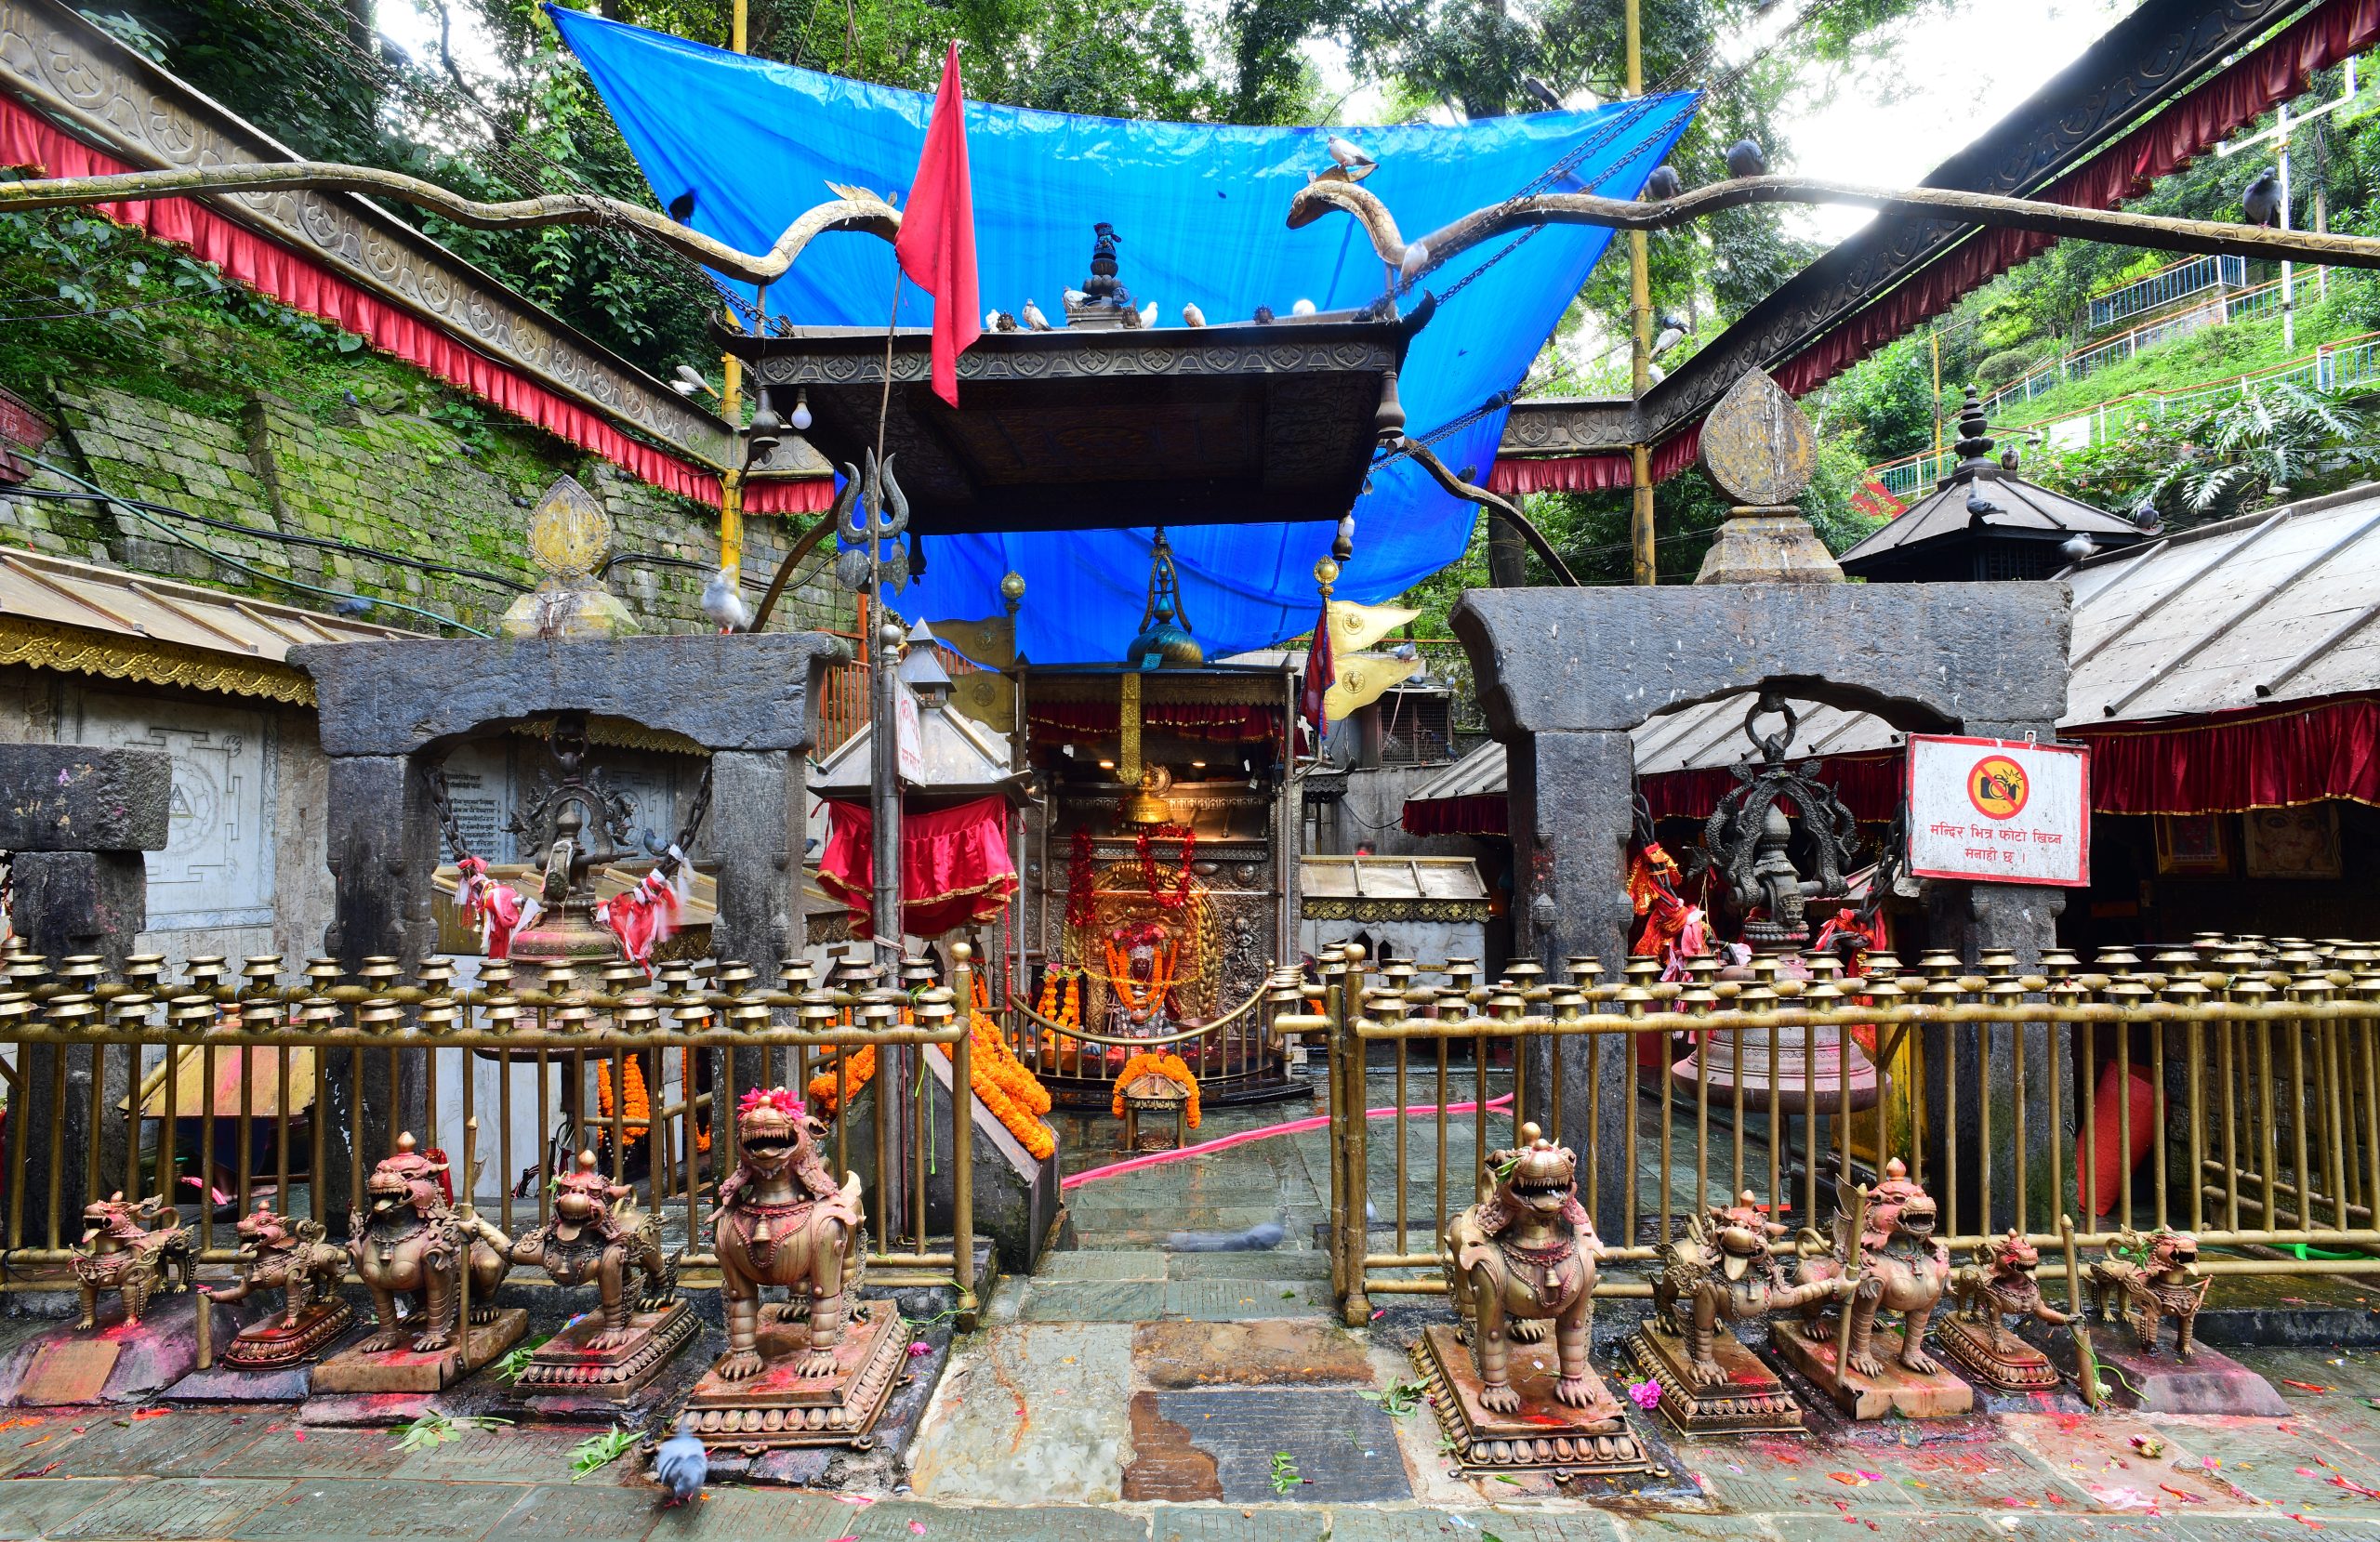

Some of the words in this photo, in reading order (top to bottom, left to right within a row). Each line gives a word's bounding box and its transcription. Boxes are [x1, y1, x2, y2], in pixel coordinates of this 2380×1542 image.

[1930, 821, 1964, 839] मन्दिर
[1970, 824, 1993, 839] भित्र
[1999, 828, 2028, 842] फोटो
[2032, 828, 2063, 844] खिच्न
[1964, 847, 1998, 863] मनाही
[2003, 850, 2015, 863] छ
